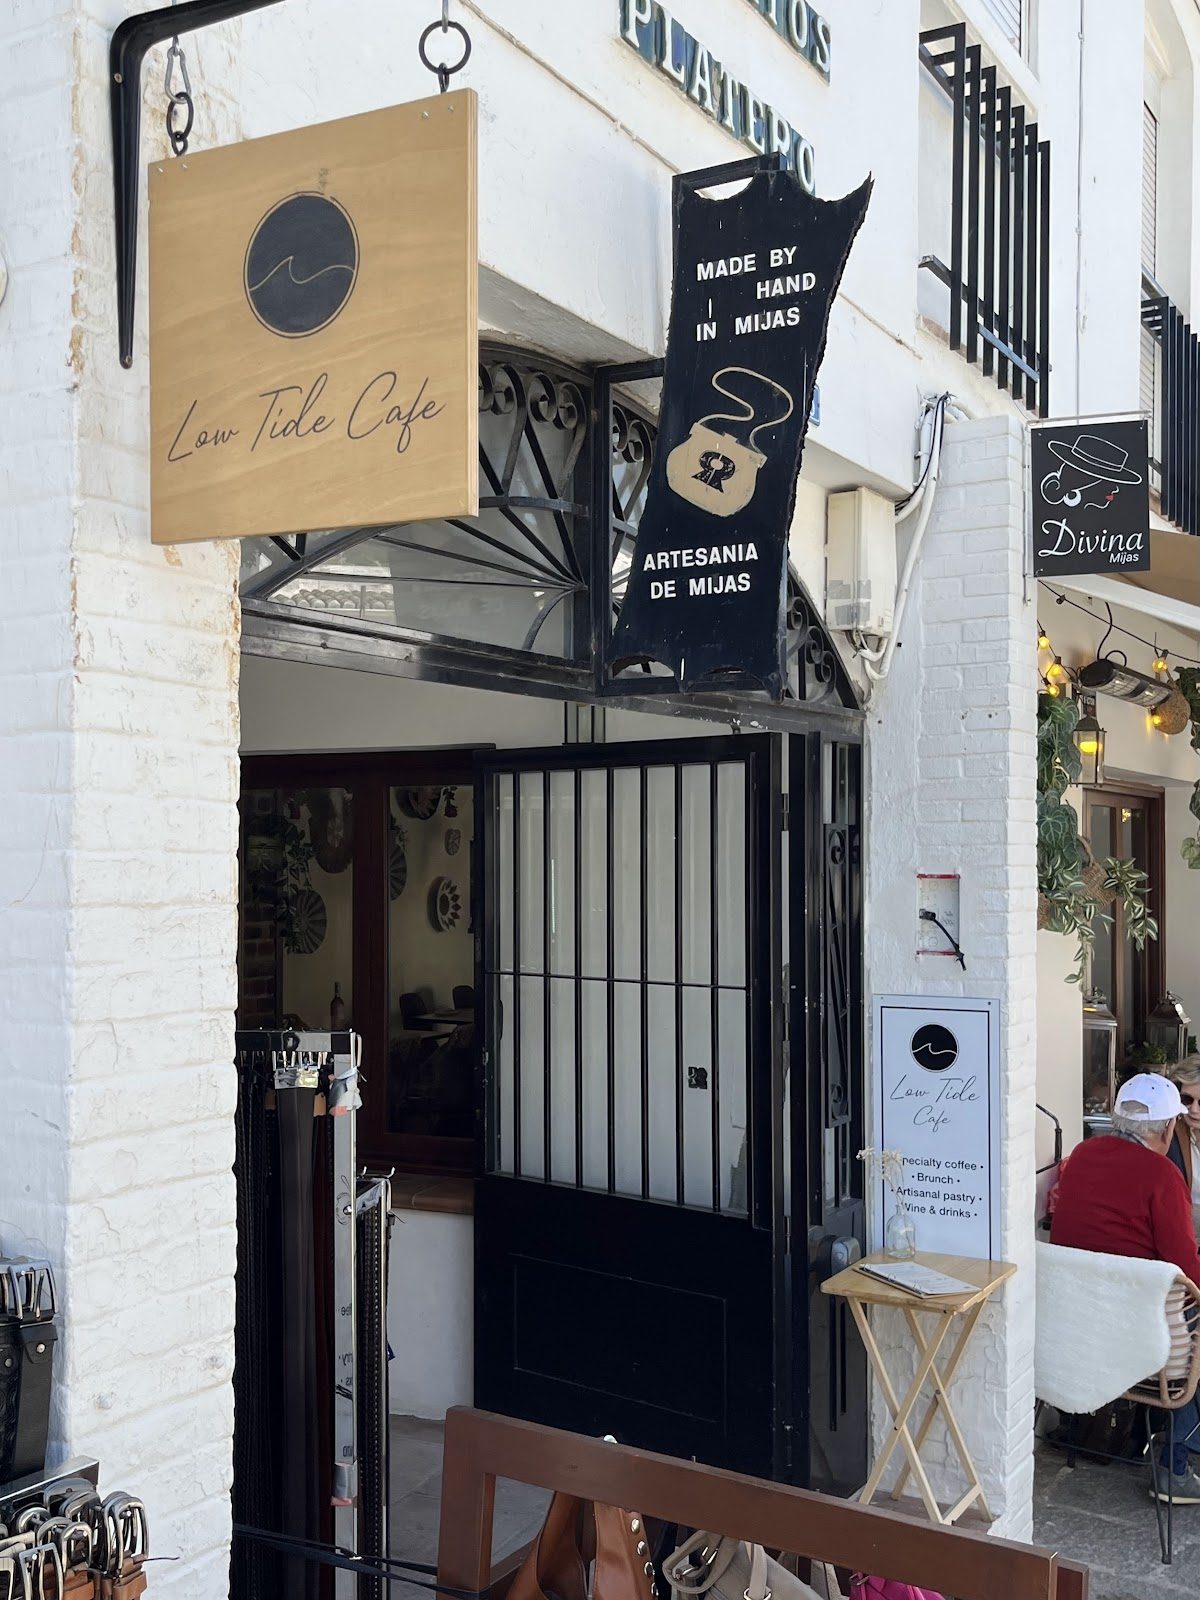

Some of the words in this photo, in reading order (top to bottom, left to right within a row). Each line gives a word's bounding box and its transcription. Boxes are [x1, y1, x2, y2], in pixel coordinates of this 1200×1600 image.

[625, 0, 815, 194] PLATERO
[697, 253, 757, 281] MADE
[770, 246, 797, 268] BY
[756, 272, 816, 300] HAND
[696, 321, 717, 342] IN
[735, 306, 800, 336] MIJAS
[168, 399, 239, 462] Low
[251, 372, 335, 452] Tide
[347, 371, 446, 453] Cafe
[1038, 518, 1144, 557] Divina
[643, 542, 759, 572] ARTESANIA
[1109, 551, 1140, 564] Mijas
[650, 580, 677, 600] DE
[689, 573, 751, 597] MIJAS
[890, 1074, 930, 1101] Low
[935, 1075, 981, 1103] Tide
[913, 1105, 953, 1133] Cafe
[902, 1157, 942, 1170] pecialty
[944, 1160, 977, 1171] coffee
[917, 1172, 954, 1185] Brunch
[896, 1186, 940, 1200] Artisanal
[943, 1192, 976, 1205] pastry
[929, 1205, 936, 1215] &
[939, 1206, 971, 1219] drinks
